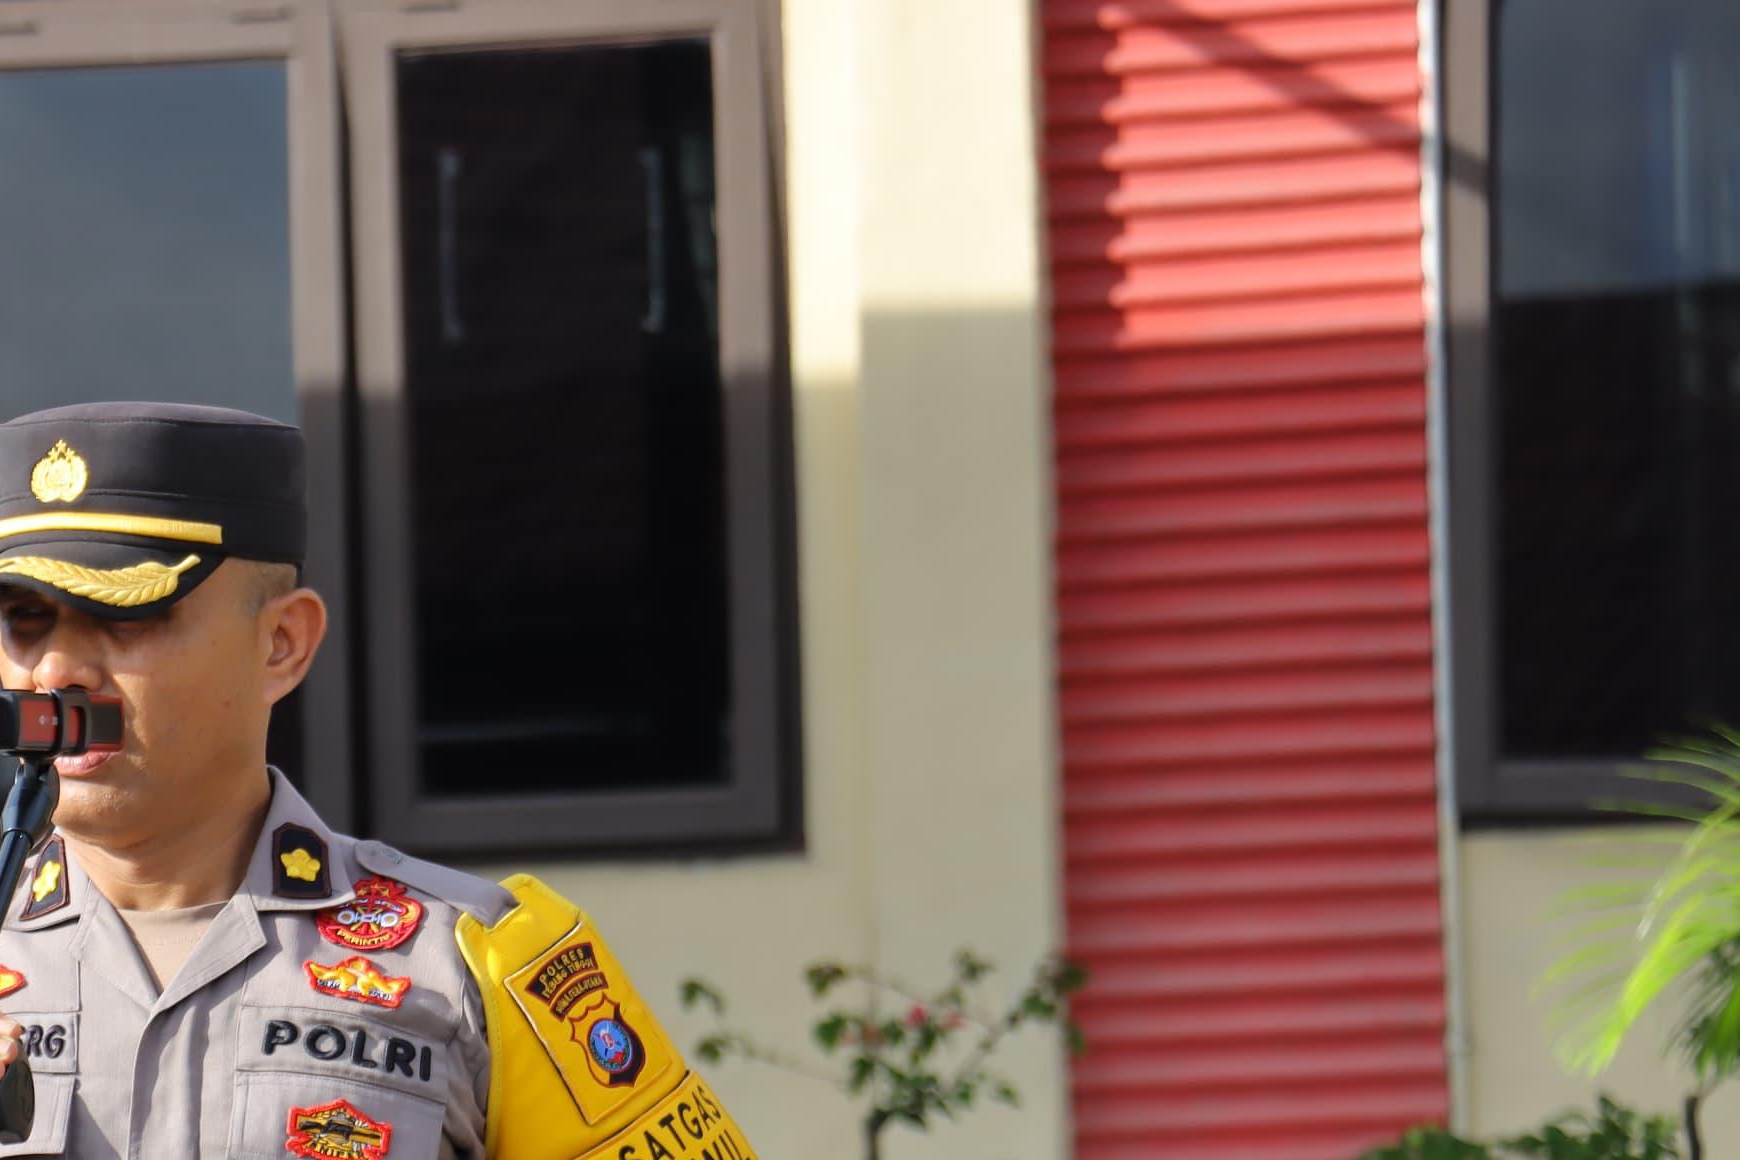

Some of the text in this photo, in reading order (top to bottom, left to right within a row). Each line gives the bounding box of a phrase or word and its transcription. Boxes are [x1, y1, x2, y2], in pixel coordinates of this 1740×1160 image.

[539, 947, 585, 987] POLRES
[18, 1023, 68, 1060] RG
[262, 1020, 432, 1082] POLRI
